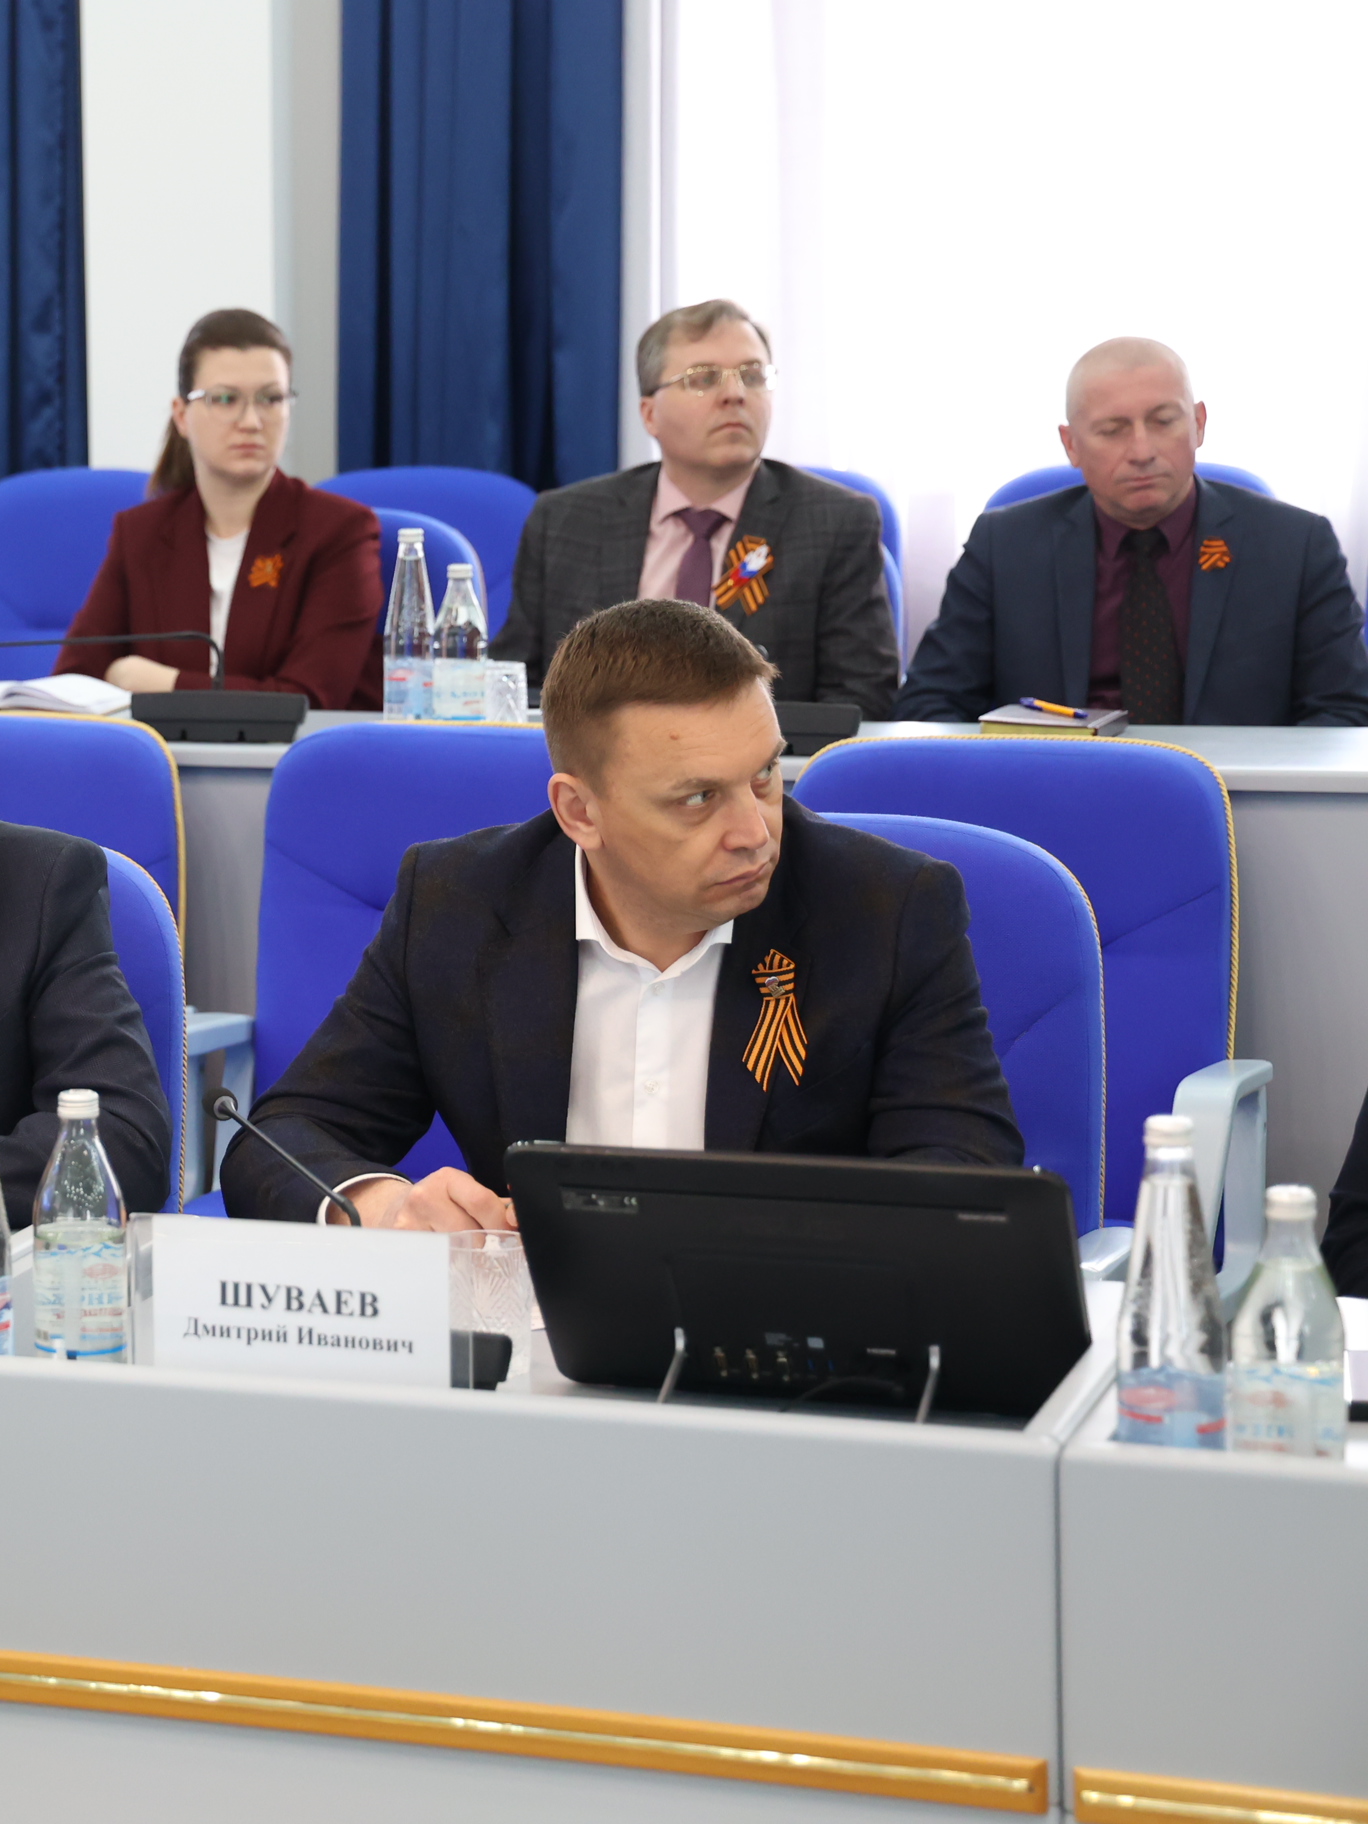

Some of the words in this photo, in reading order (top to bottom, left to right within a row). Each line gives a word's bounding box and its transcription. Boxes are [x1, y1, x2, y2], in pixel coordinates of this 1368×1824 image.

[218, 1280, 380, 1319] ШУВАЕВ
[183, 1317, 288, 1346] Дмитрий
[297, 1326, 414, 1354] Иванович
